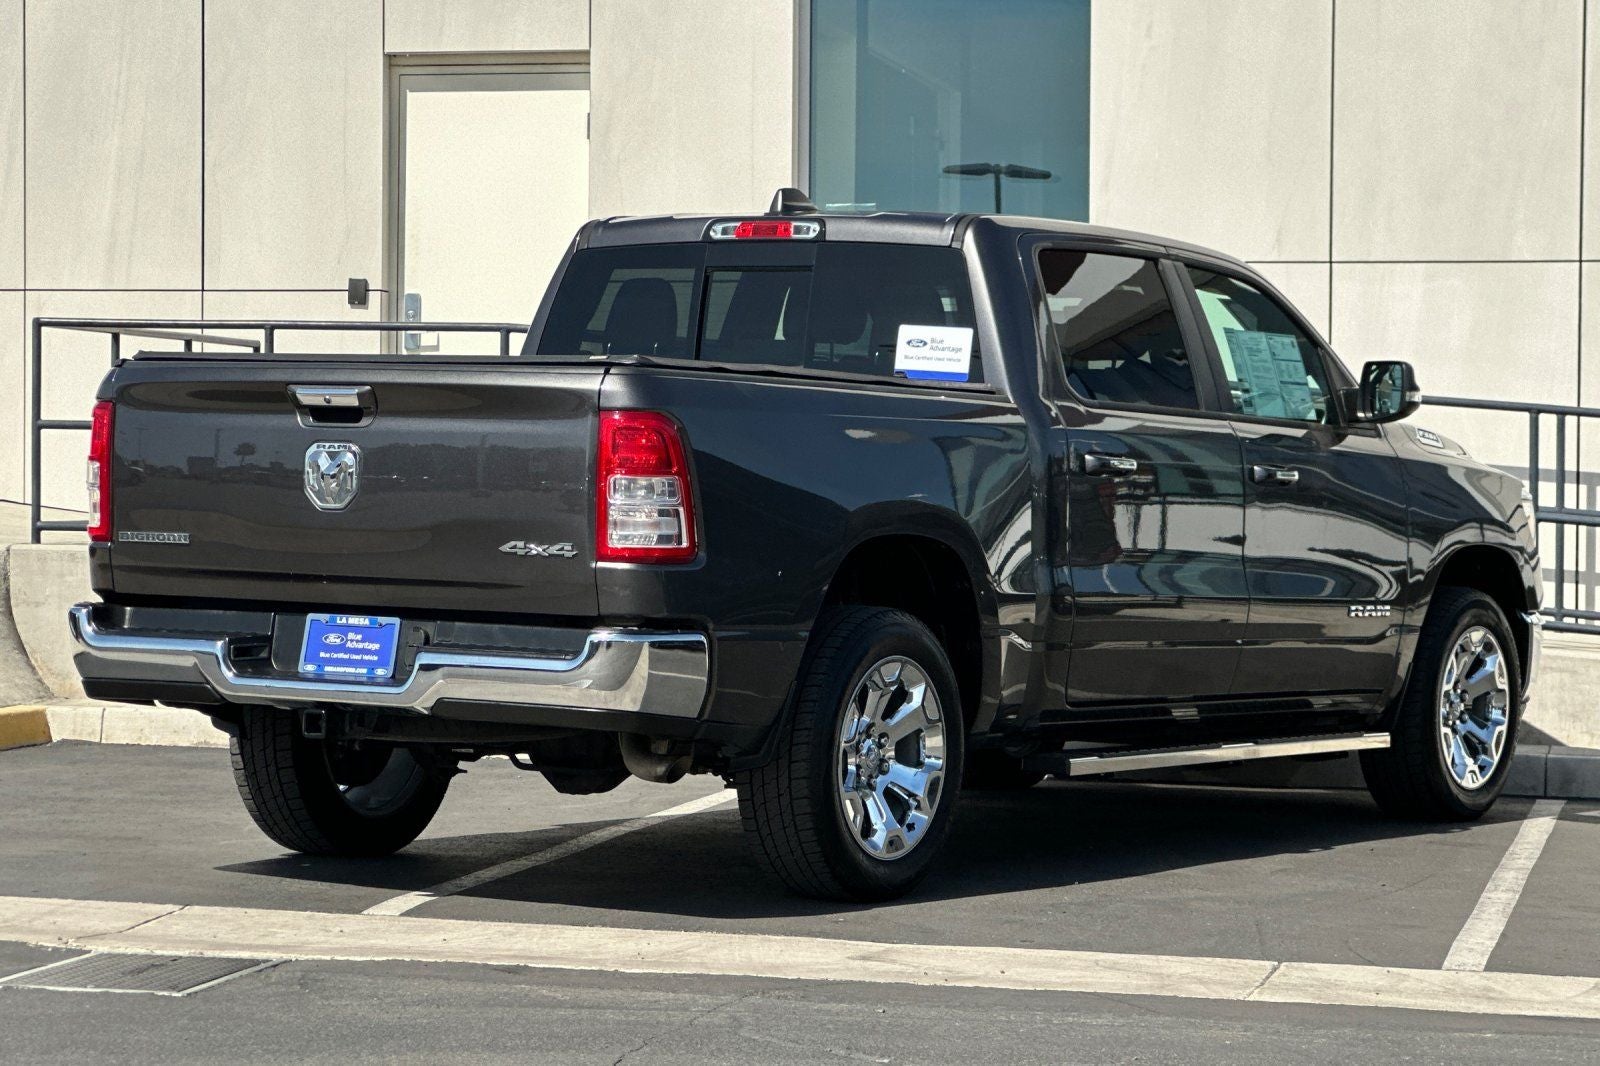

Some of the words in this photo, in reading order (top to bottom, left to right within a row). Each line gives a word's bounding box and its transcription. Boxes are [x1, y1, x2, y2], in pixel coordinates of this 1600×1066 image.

[929, 345, 963, 354] Advantage
[118, 531, 190, 544] BIGHORN
[1349, 605, 1391, 617] RAM
[337, 616, 347, 624] LA
[348, 617, 369, 625] MESA
[347, 632, 362, 641] Blue
[346, 641, 380, 650] Advantage
[362, 653, 378, 661] Vehicle
